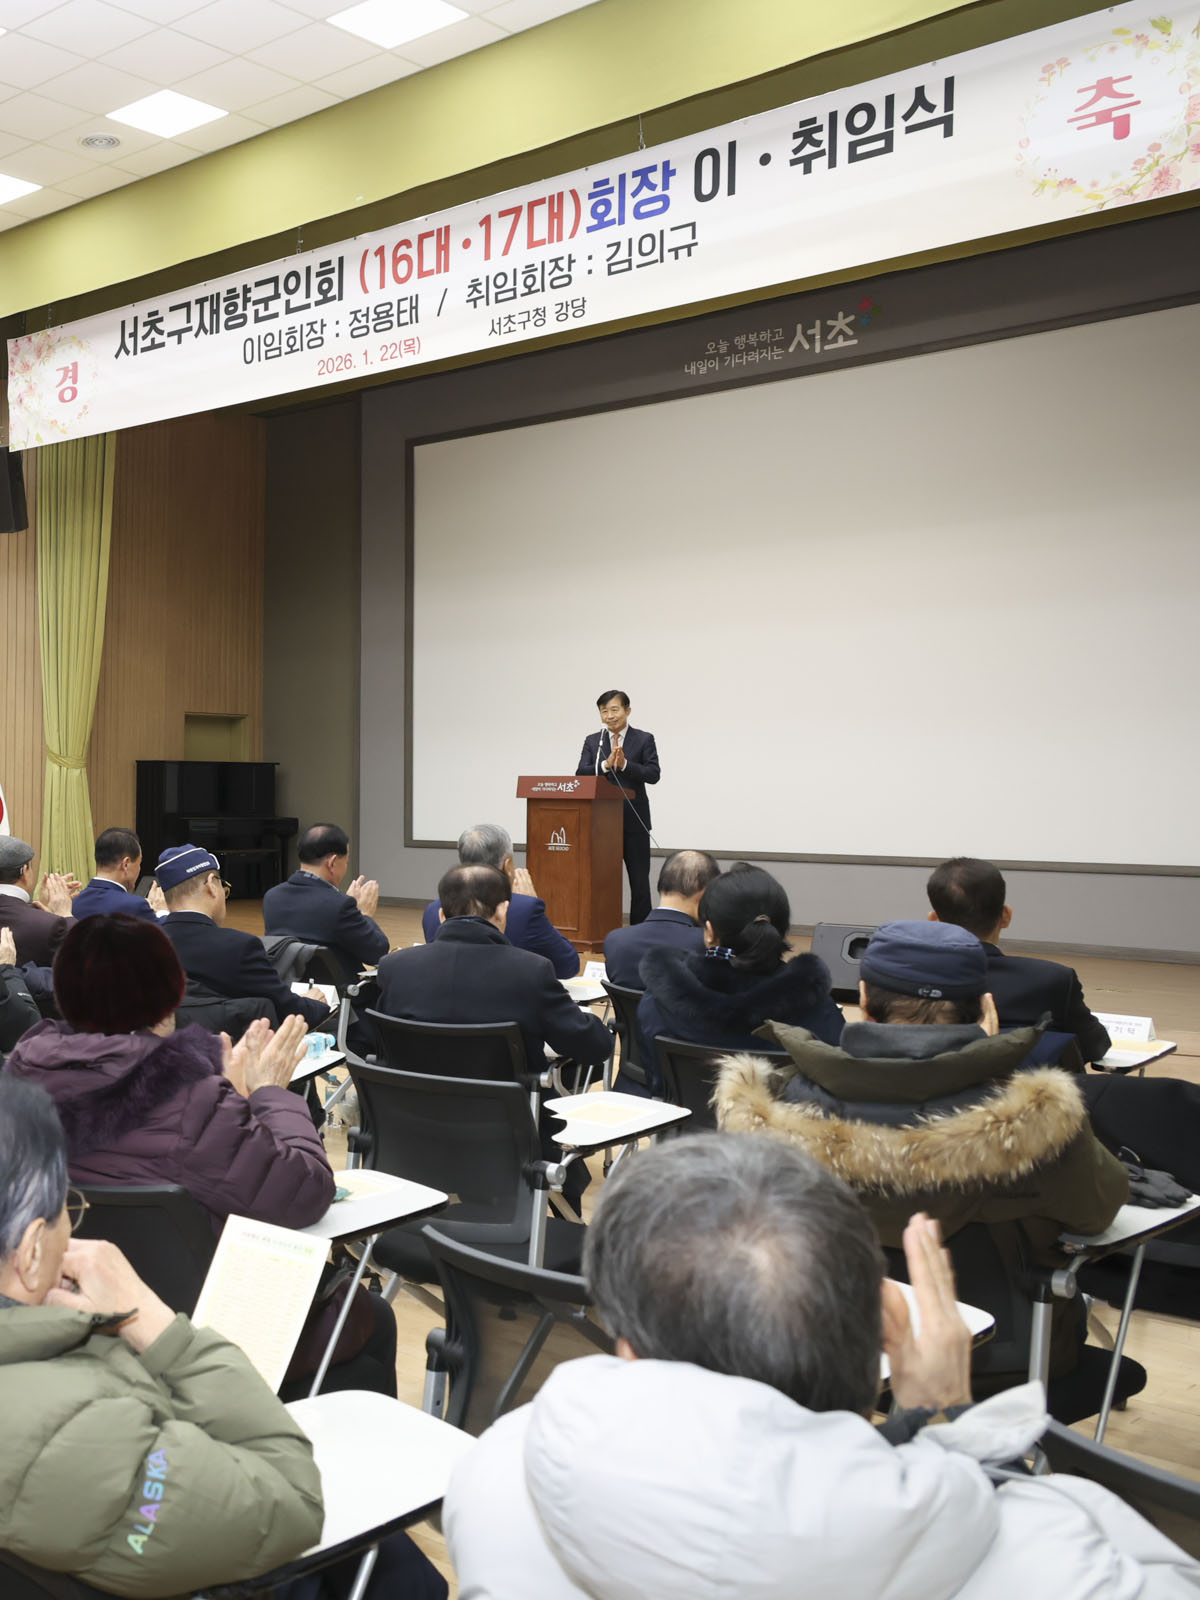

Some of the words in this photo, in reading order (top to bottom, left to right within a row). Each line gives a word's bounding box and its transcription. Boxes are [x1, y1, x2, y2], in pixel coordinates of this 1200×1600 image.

[1067, 74, 1142, 141] 축
[113, 255, 345, 360] 서초구재향군인회
[242, 318, 328, 365] 이임회장
[348, 293, 420, 339] 정용태
[465, 253, 577, 309] 취임회장
[605, 221, 699, 277] 김의규
[488, 306, 548, 337] 서초구청
[554, 296, 587, 322] 강당
[788, 311, 859, 354] 서초
[316, 353, 357, 376] 2026.
[379, 336, 422, 362] 22(목)
[684, 356, 720, 376] 내일이
[723, 345, 785, 369] 기다려지는
[704, 339, 730, 356] 오늘
[733, 327, 785, 351] 행복하고
[55, 360, 79, 404] 경
[557, 781, 575, 793] 서초
[126, 1447, 168, 1555] ALASKA
